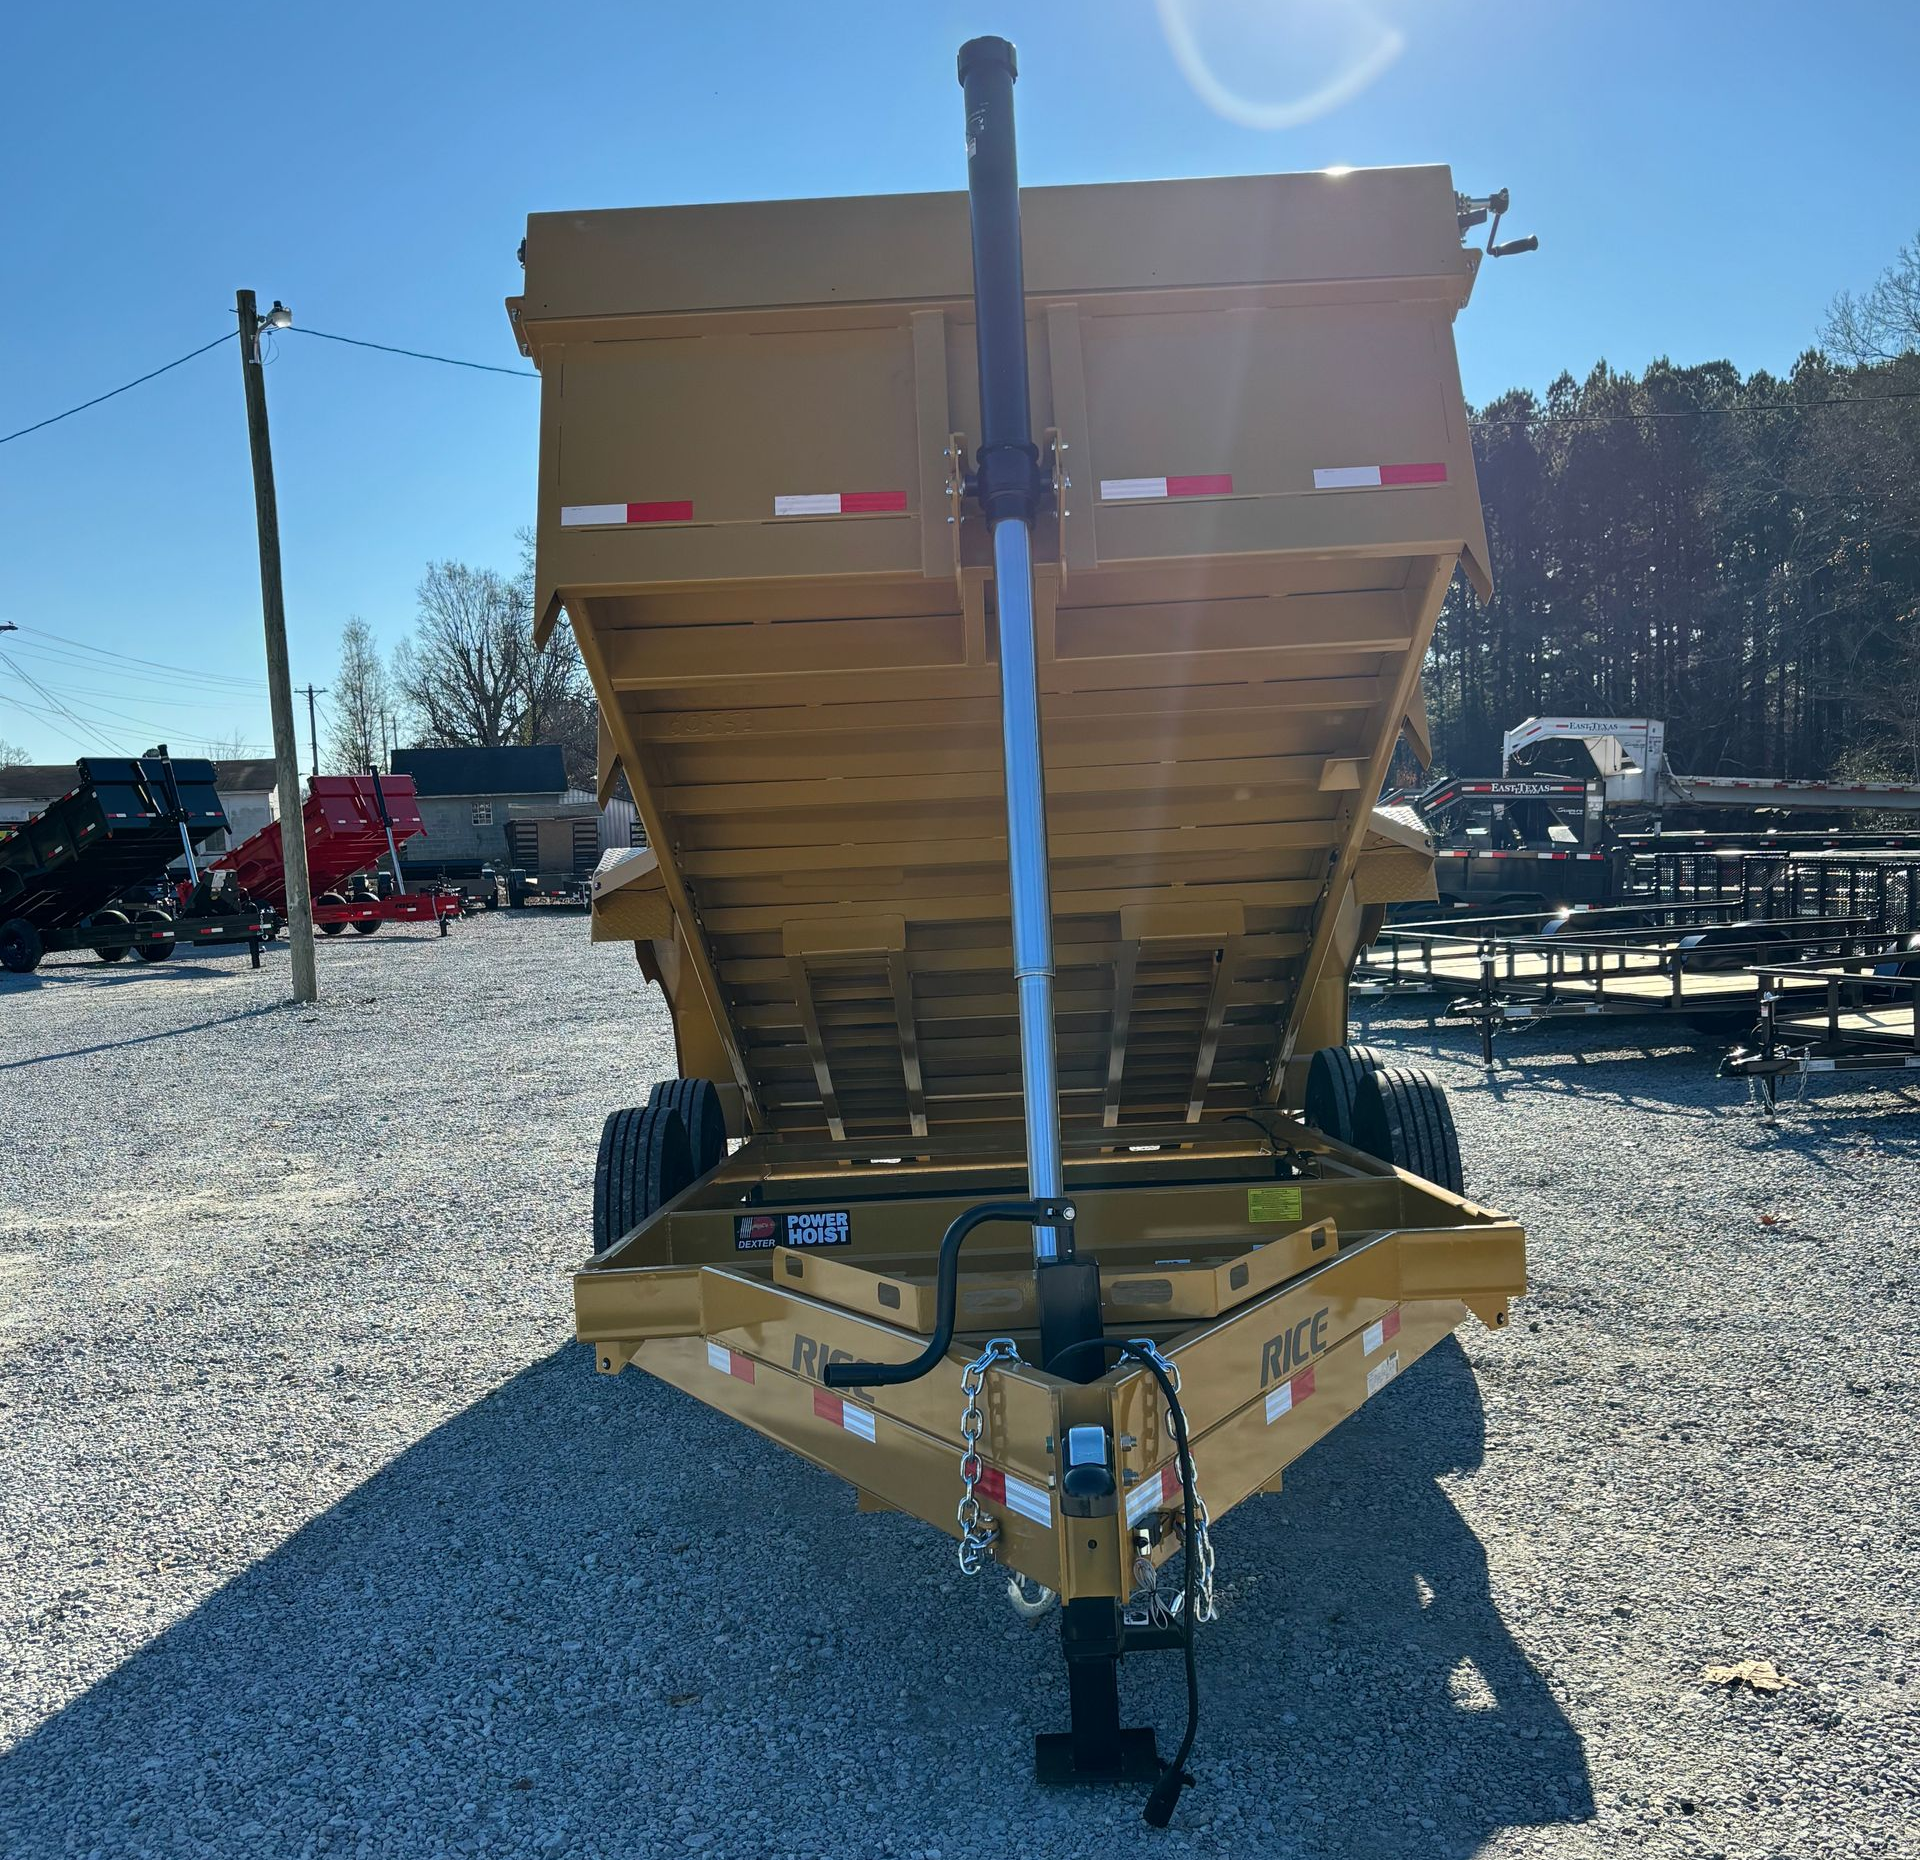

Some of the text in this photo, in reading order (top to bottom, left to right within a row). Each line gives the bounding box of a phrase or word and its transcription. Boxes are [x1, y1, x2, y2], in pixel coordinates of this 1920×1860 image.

[1491, 783, 1516, 792] EAST
[1517, 783, 1550, 793] TEXAS
[788, 1213, 848, 1228] POWER
[788, 1226, 849, 1245] HOIST
[738, 1239, 776, 1249] DEXTER
[1260, 1307, 1329, 1389] RICE
